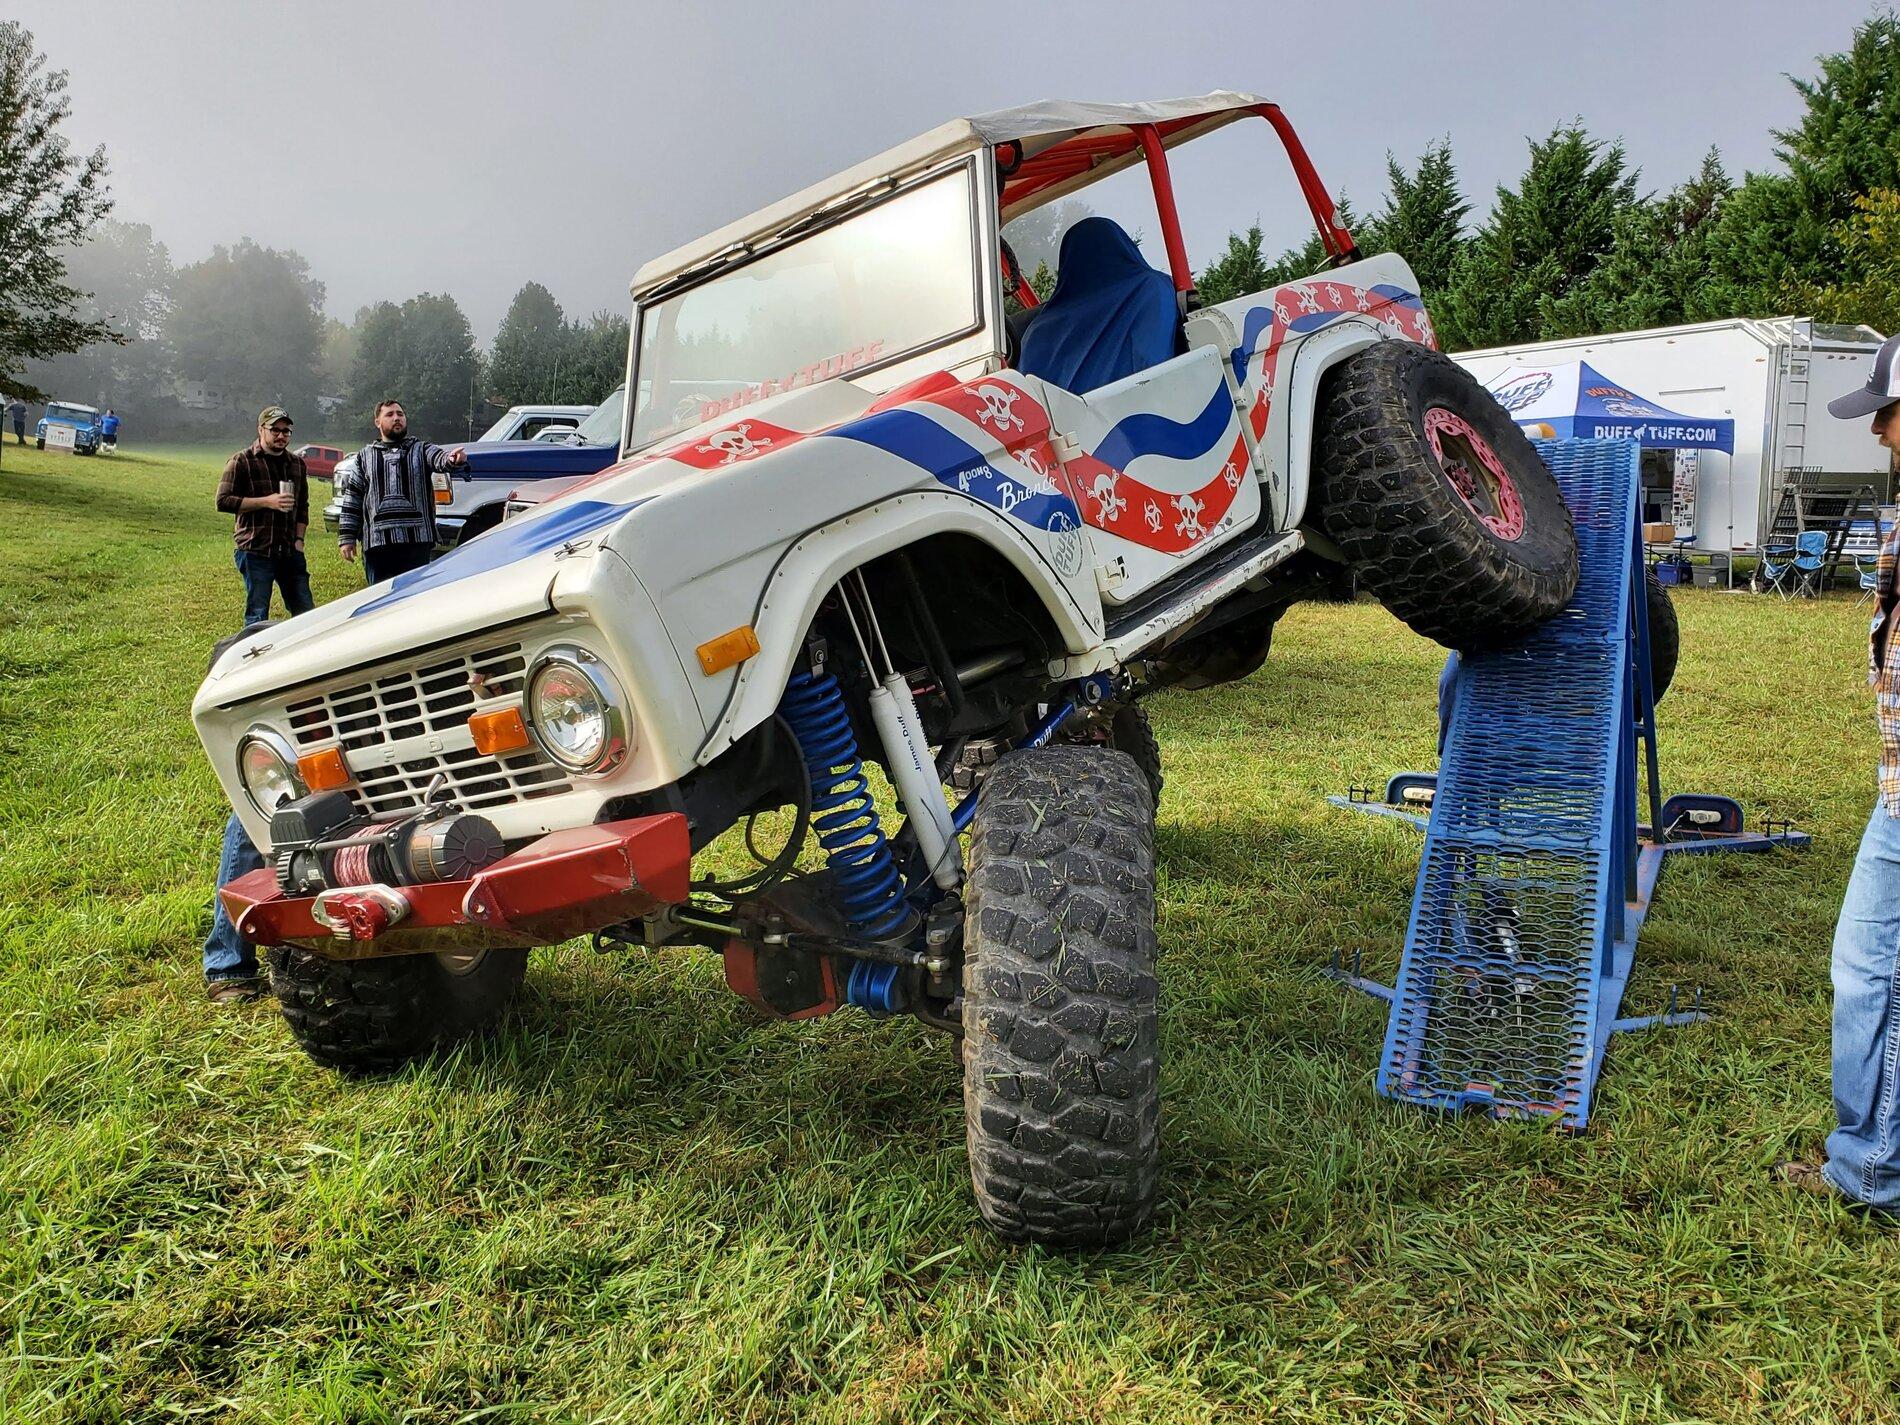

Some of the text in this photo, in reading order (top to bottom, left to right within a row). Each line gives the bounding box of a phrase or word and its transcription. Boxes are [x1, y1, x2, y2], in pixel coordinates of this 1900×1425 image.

[800, 339, 884, 386] TUFF
[1594, 426, 1716, 442] DUFF TUFF.COM
[996, 476, 1057, 513] Bronco
